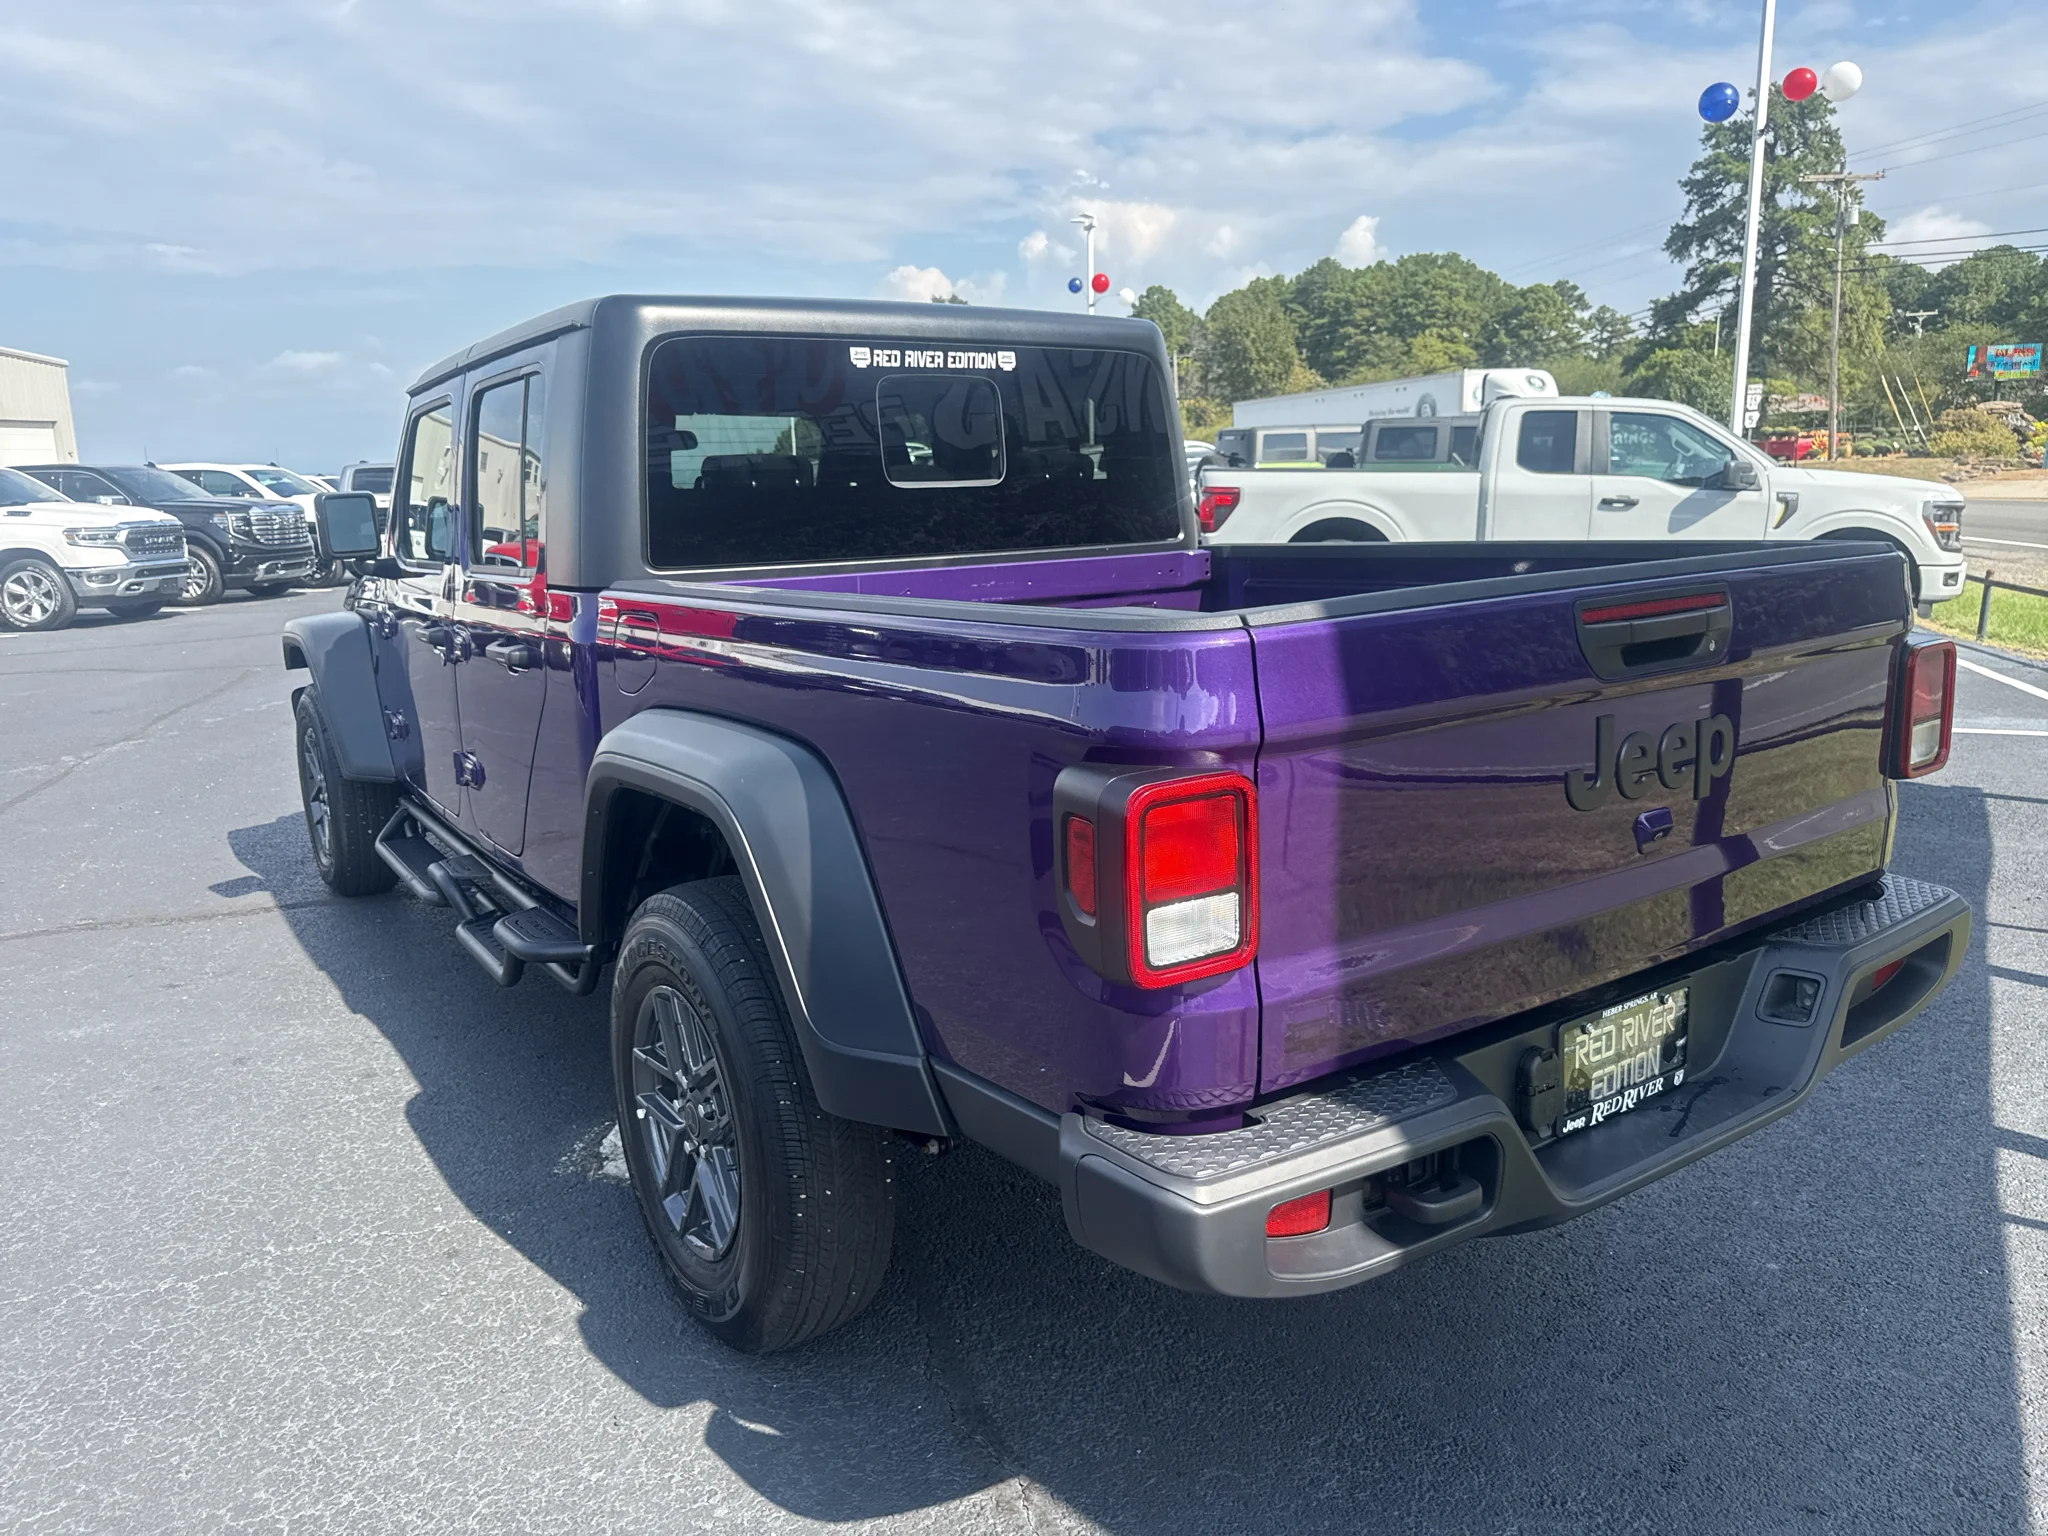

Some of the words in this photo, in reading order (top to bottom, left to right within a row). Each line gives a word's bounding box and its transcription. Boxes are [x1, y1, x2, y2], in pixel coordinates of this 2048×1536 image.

[873, 350, 901, 367] RED
[905, 350, 943, 368] RIVER
[948, 351, 997, 369] EDITION
[1748, 415, 1754, 425] 5
[1564, 713, 1734, 811] Jeep
[1602, 1005, 1624, 1019] HEBER
[1650, 992, 1658, 1000] AR
[1575, 1025, 1615, 1068] RED
[1621, 1002, 1676, 1051] RIVER
[1591, 1045, 1660, 1100] EDITION
[1563, 1116, 1586, 1133] Jeep
